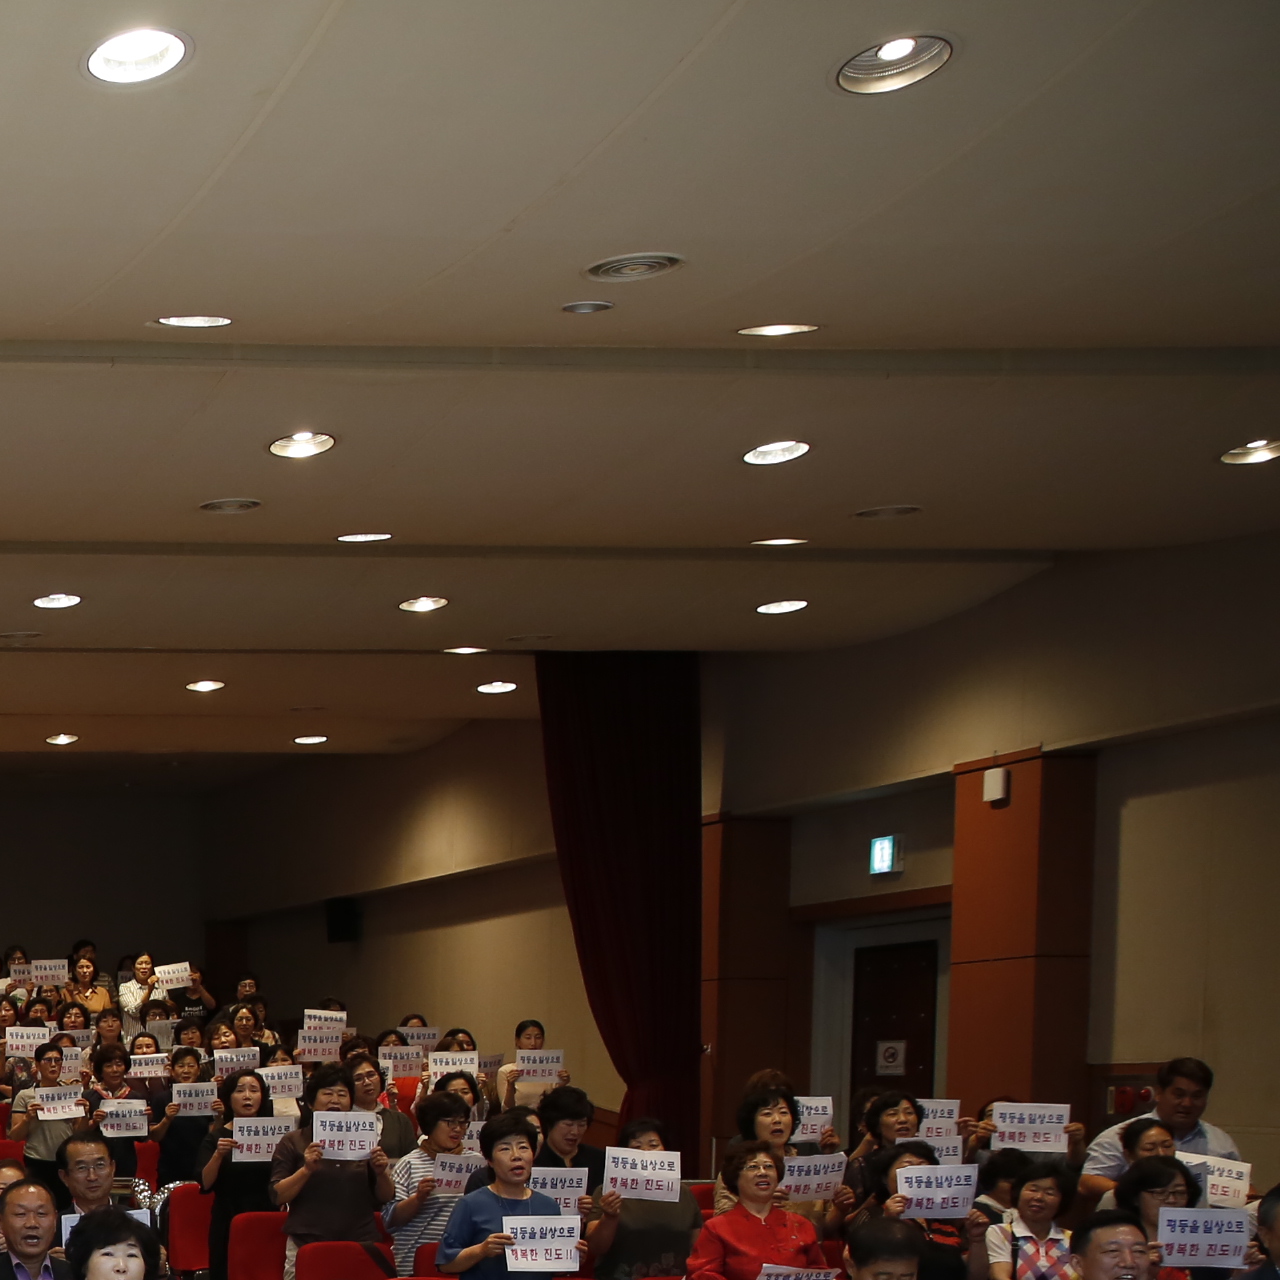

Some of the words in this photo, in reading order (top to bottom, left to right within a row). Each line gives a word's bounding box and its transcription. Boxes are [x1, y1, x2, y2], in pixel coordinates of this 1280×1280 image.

[998, 1112, 1025, 1124] 평등을
[1027, 1113, 1065, 1125] 일상으로
[238, 1126, 260, 1136] 평등을
[319, 1120, 344, 1132] 평등을
[345, 1120, 375, 1131] 일상으로
[319, 1138, 345, 1151] 행복한
[997, 1131, 1026, 1143] 행복한
[1031, 1132, 1062, 1144] 진도!!
[439, 1160, 463, 1174] 평등을
[611, 1156, 638, 1170] 평등을
[639, 1158, 676, 1172] 일상으로
[787, 1163, 812, 1177] 평등을
[813, 1161, 844, 1176] 일상으로
[550, 1176, 583, 1189] 일상으로
[609, 1176, 639, 1190] 행복한
[644, 1178, 674, 1192] 진도!!
[904, 1175, 933, 1189] 평등을
[934, 1174, 972, 1188] 일상으로
[939, 1195, 970, 1209] 진도!!
[509, 1226, 537, 1240] 평등을
[539, 1225, 575, 1239] 일상으로
[1165, 1219, 1198, 1234] 평등을
[1200, 1219, 1244, 1234] 일상으로
[510, 1248, 538, 1261] 행복한
[543, 1248, 572, 1261] 진도!!
[1163, 1243, 1199, 1257] 행복한
[1205, 1243, 1241, 1257] 진도!!
